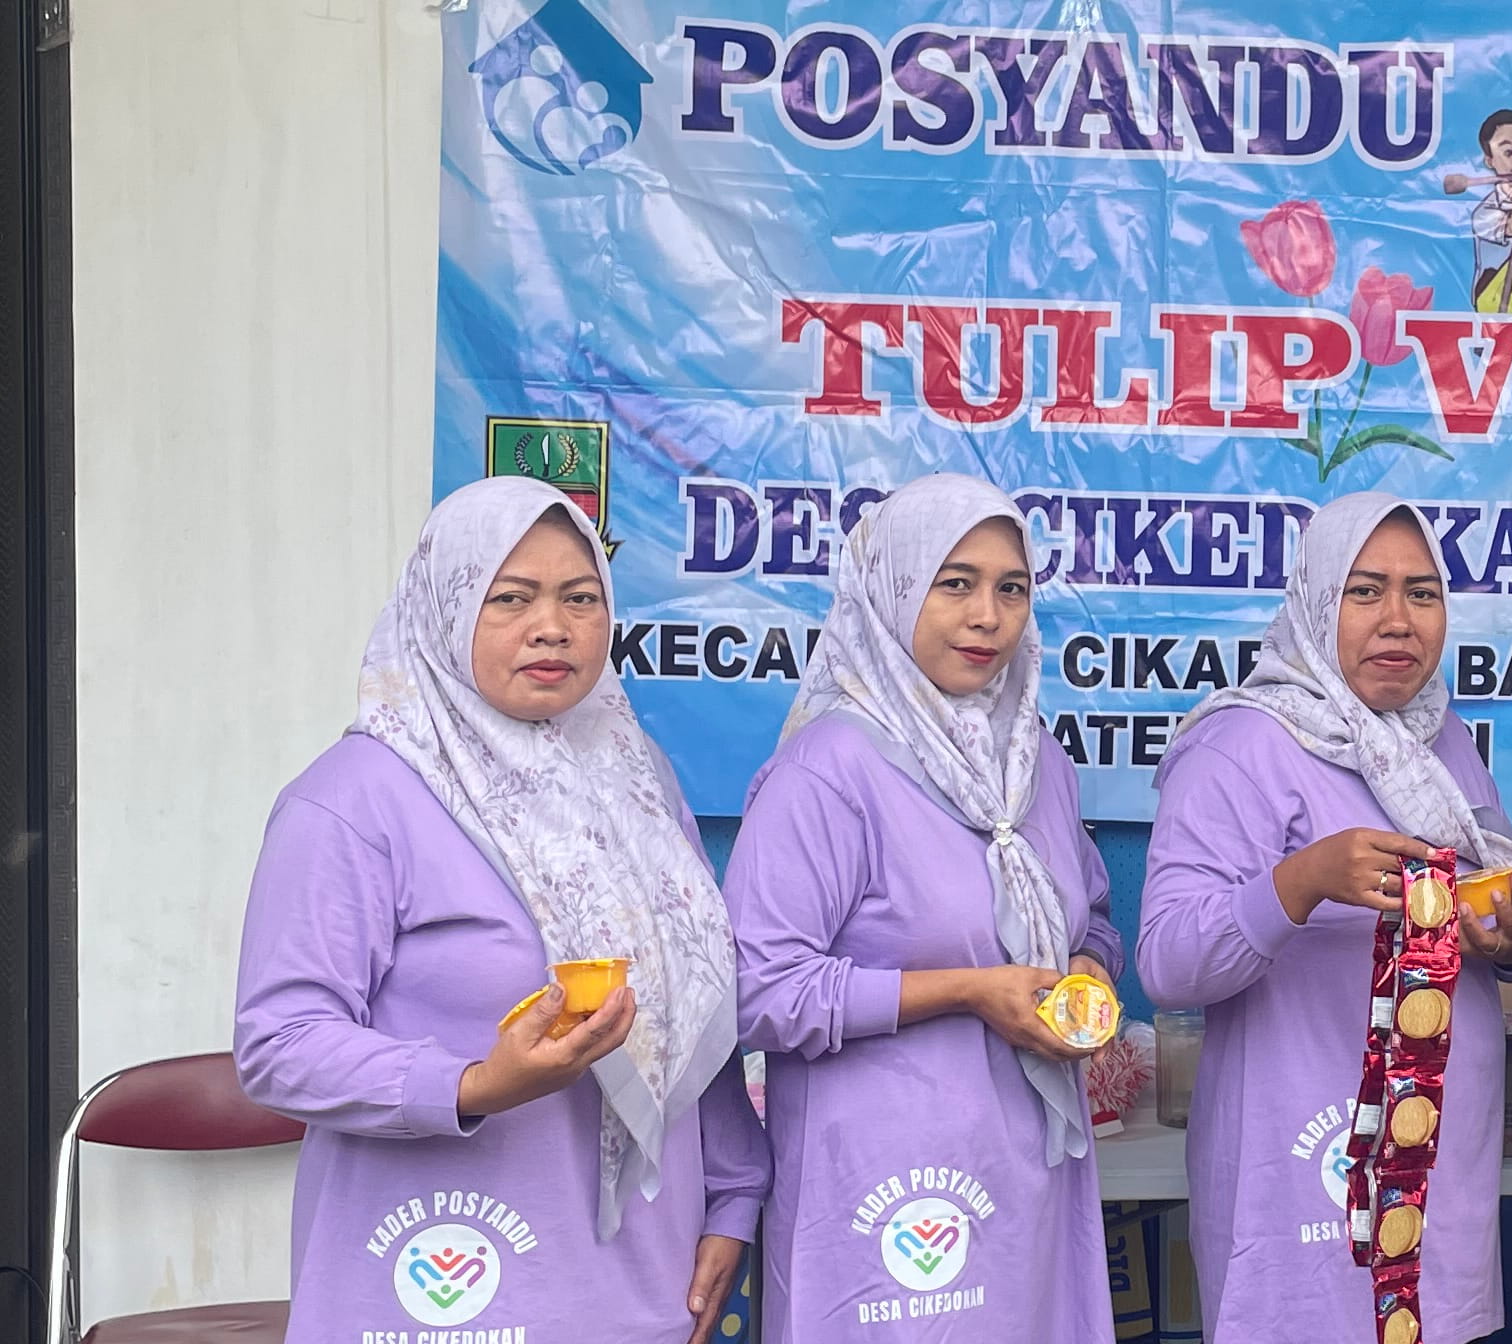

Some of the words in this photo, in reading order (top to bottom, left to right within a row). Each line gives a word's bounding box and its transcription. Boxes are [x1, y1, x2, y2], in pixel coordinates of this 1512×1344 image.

[681, 23, 1445, 154] POSYANDU
[783, 299, 1357, 430] TULIP
[1291, 1104, 1341, 1157] KADER
[366, 1198, 427, 1258] KADER
[433, 1190, 538, 1255] POSYANDU
[851, 1175, 906, 1236] KADER
[909, 1166, 996, 1220] POSYANDU
[1300, 1222, 1340, 1244] DESA
[858, 1299, 902, 1323] DESA
[908, 1285, 985, 1318] CIKEDOKAN
